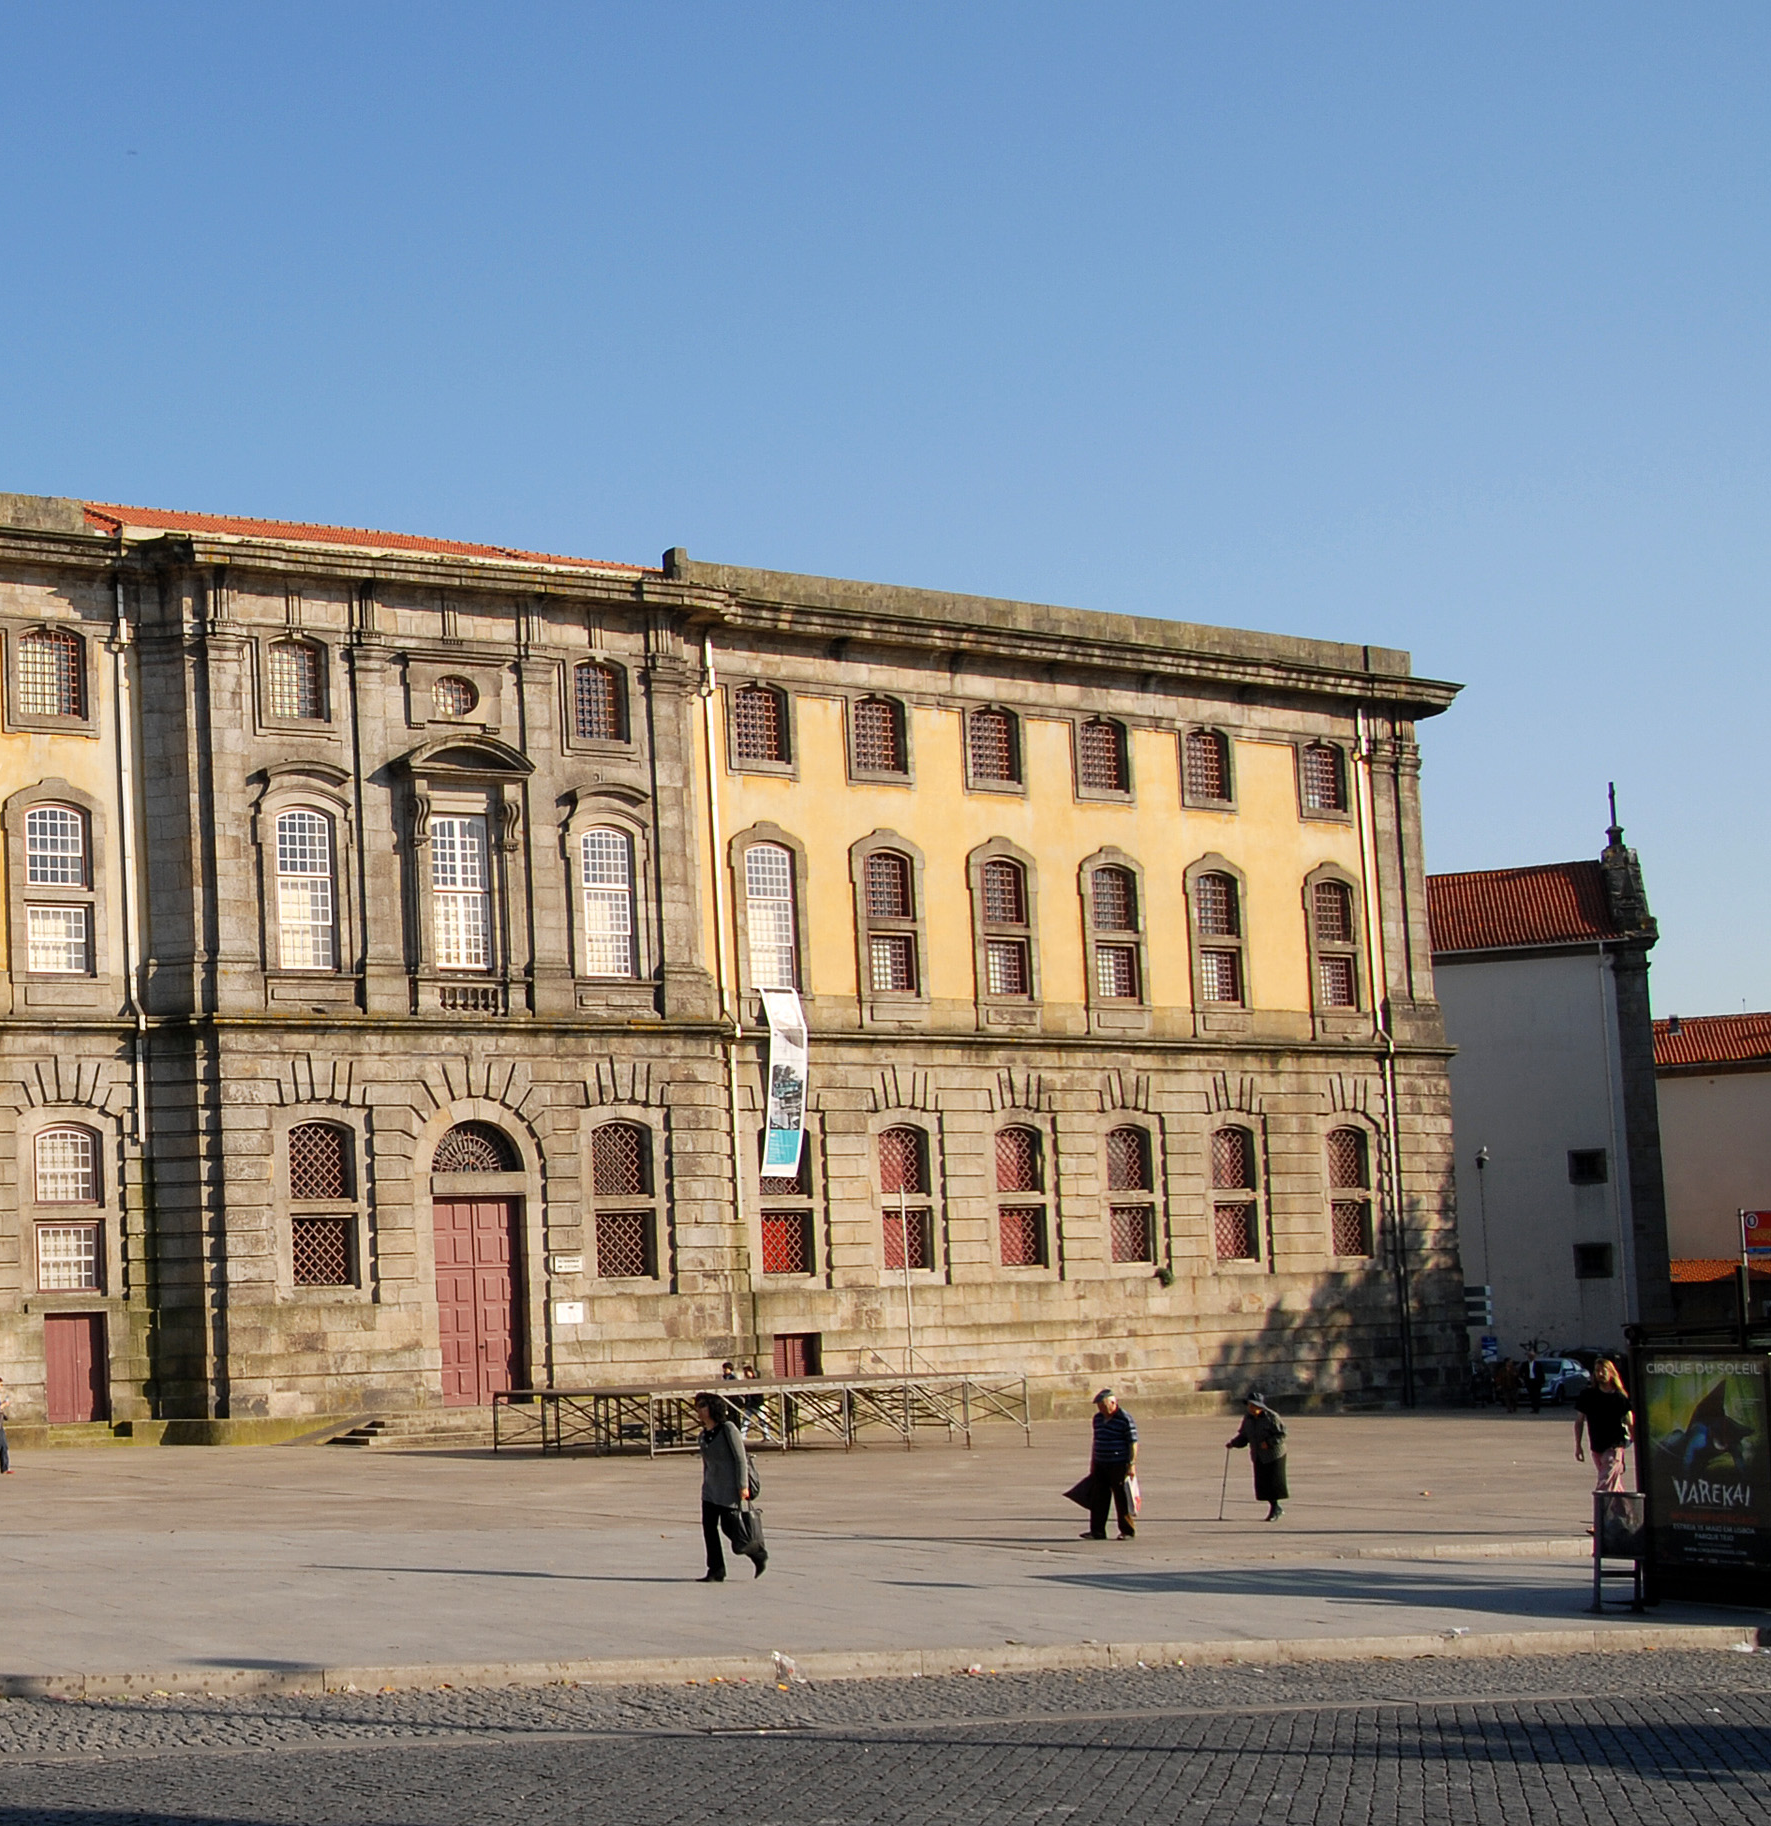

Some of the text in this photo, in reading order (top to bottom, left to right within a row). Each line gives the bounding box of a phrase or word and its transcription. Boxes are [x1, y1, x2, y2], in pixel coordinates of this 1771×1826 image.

[1646, 1363, 1761, 1377] CIRQUE DU SOLEIL
[1671, 1476, 1750, 1507] VAREKAI
